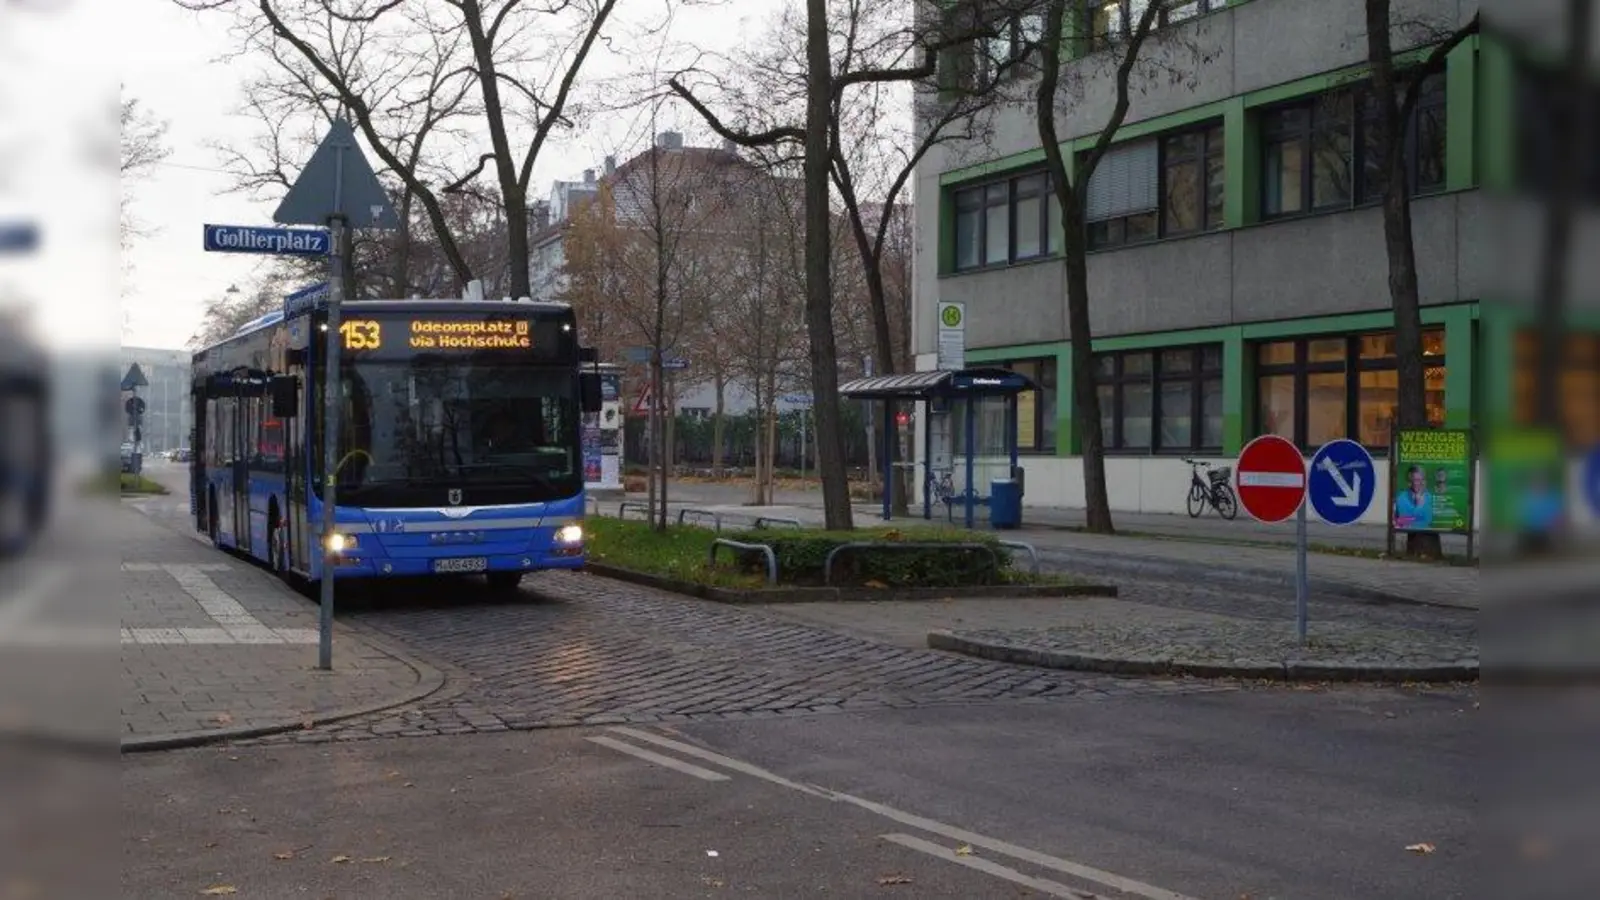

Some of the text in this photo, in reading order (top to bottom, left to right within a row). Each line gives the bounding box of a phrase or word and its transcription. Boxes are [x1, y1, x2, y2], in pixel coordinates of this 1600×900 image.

[215, 228, 322, 251] Gollierplatz
[411, 320, 512, 334] Odeonsplatz
[339, 319, 381, 349] 153
[409, 335, 531, 347] via Hochschule
[1400, 431, 1465, 442] WENIGER
[1400, 443, 1465, 453] VERKEHR
